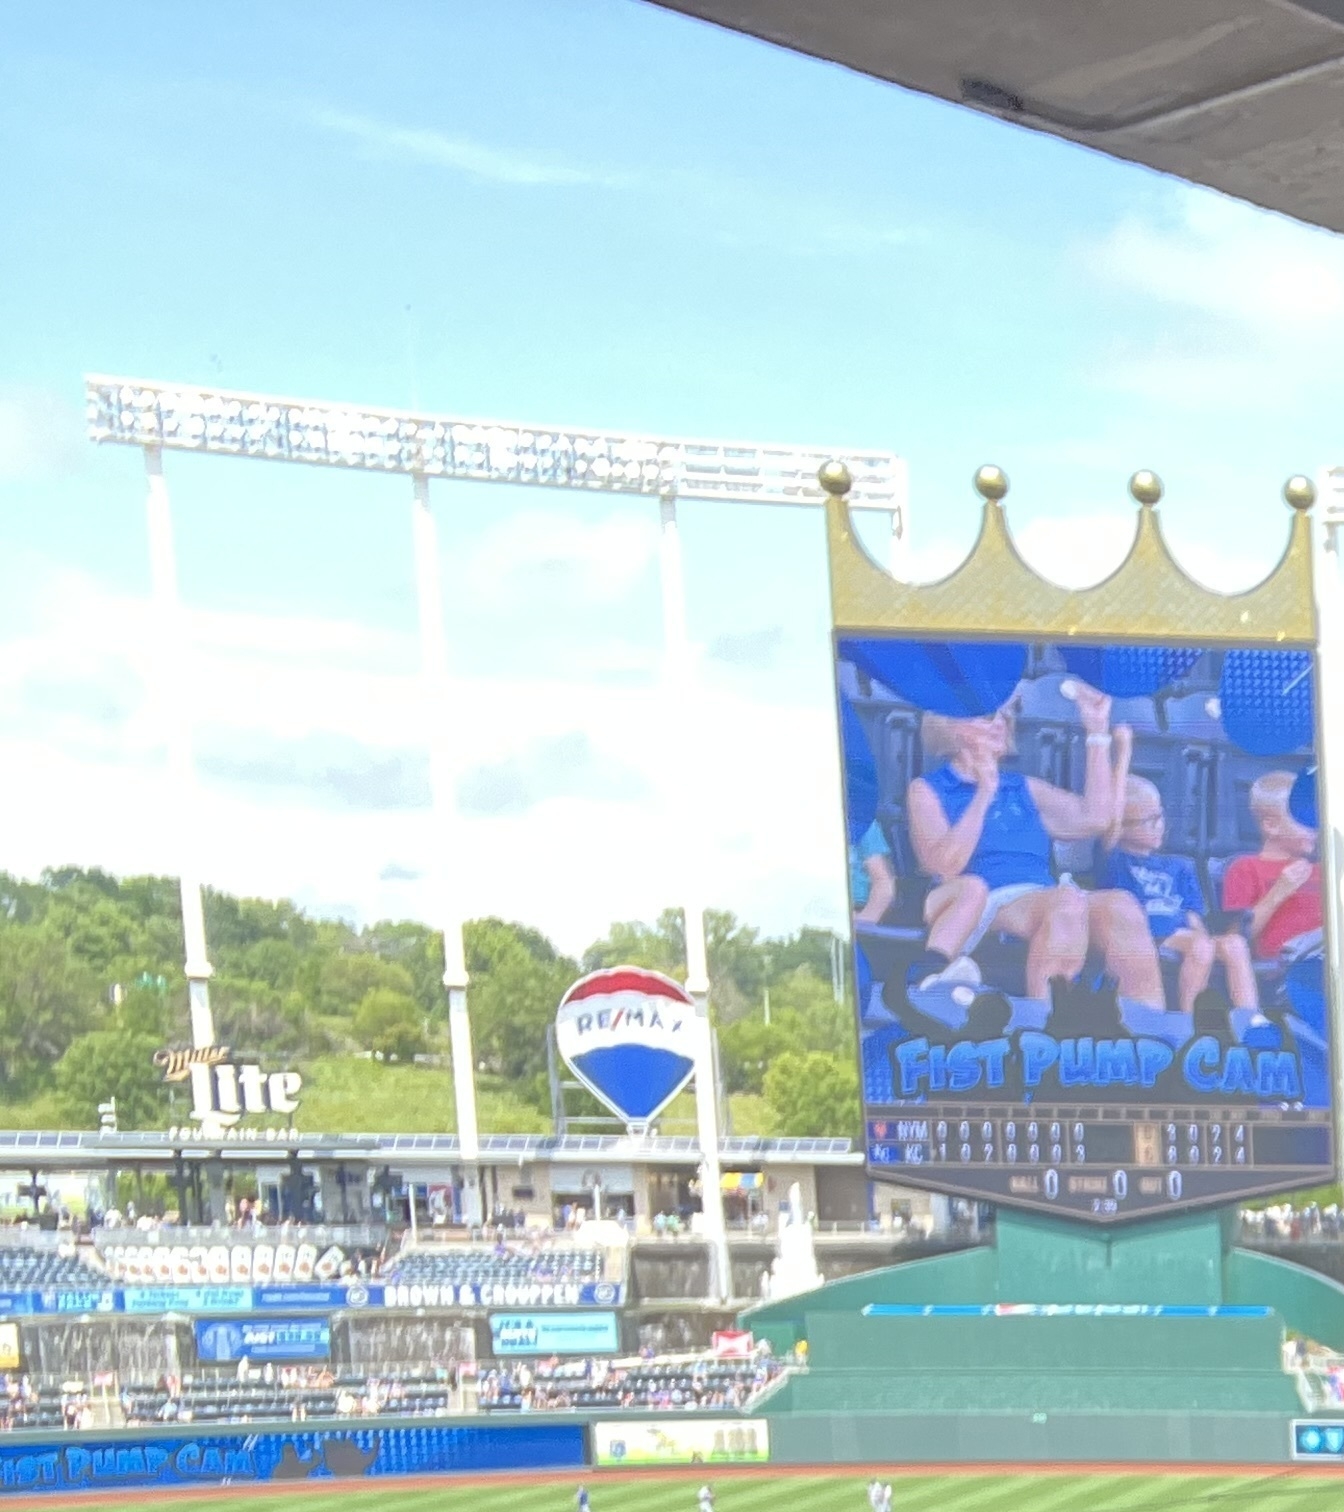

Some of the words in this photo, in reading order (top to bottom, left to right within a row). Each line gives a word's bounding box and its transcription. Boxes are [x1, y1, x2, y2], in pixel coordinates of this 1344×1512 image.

[577, 1007, 684, 1036] RE/MAX
[895, 1036, 1010, 1094] FIST
[1019, 1031, 1174, 1088] PUMP
[1183, 1036, 1302, 1097] CAM
[190, 1063, 301, 1126] Lite
[168, 1127, 258, 1141] FOUAIN
[1045, 1168, 1059, 1200] 0
[1113, 1169, 1128, 1200] 0
[1168, 1170, 1183, 1200] 0
[65, 1446, 170, 1480] PUMP
[176, 1442, 256, 1475] CAM
